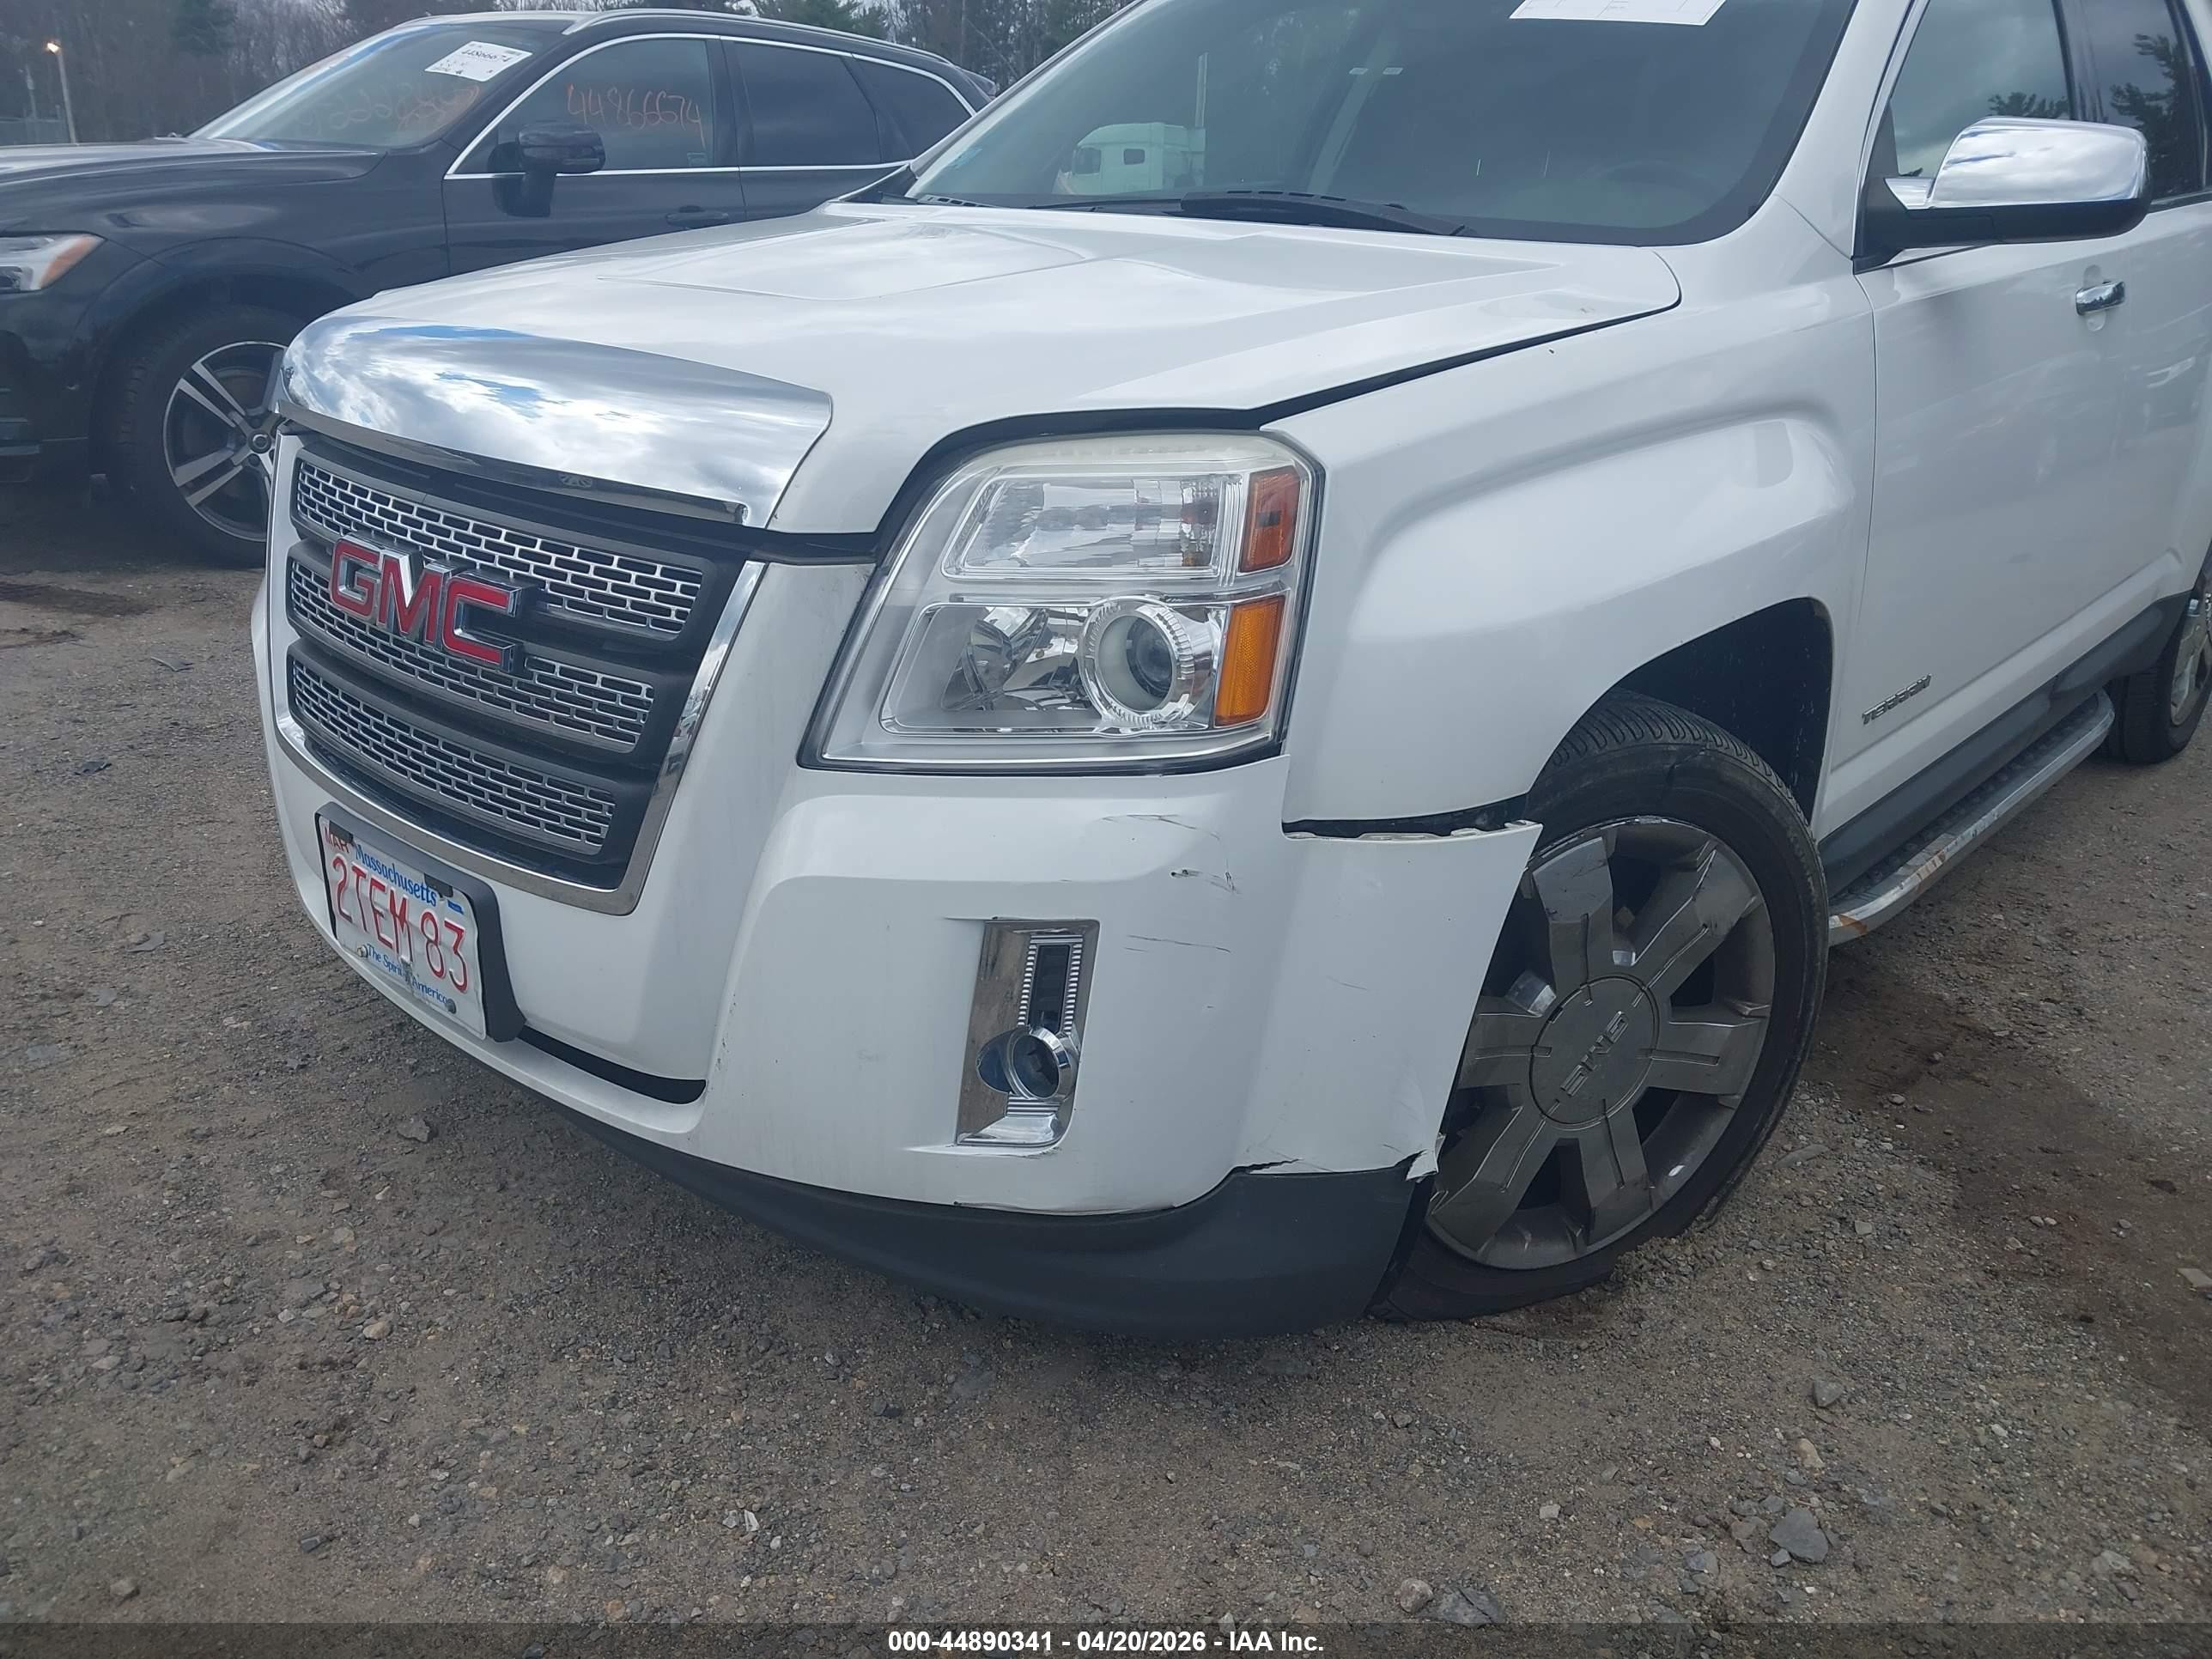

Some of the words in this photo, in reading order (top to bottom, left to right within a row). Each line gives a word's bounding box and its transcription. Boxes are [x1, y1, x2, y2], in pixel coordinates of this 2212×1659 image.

[330, 533, 521, 672] GMC
[332, 856, 413, 963] 2TEM
[420, 911, 468, 993] 83
[356, 843, 437, 907] Massachusetts
[367, 943, 381, 962] The
[383, 954, 404, 977] Spirit
